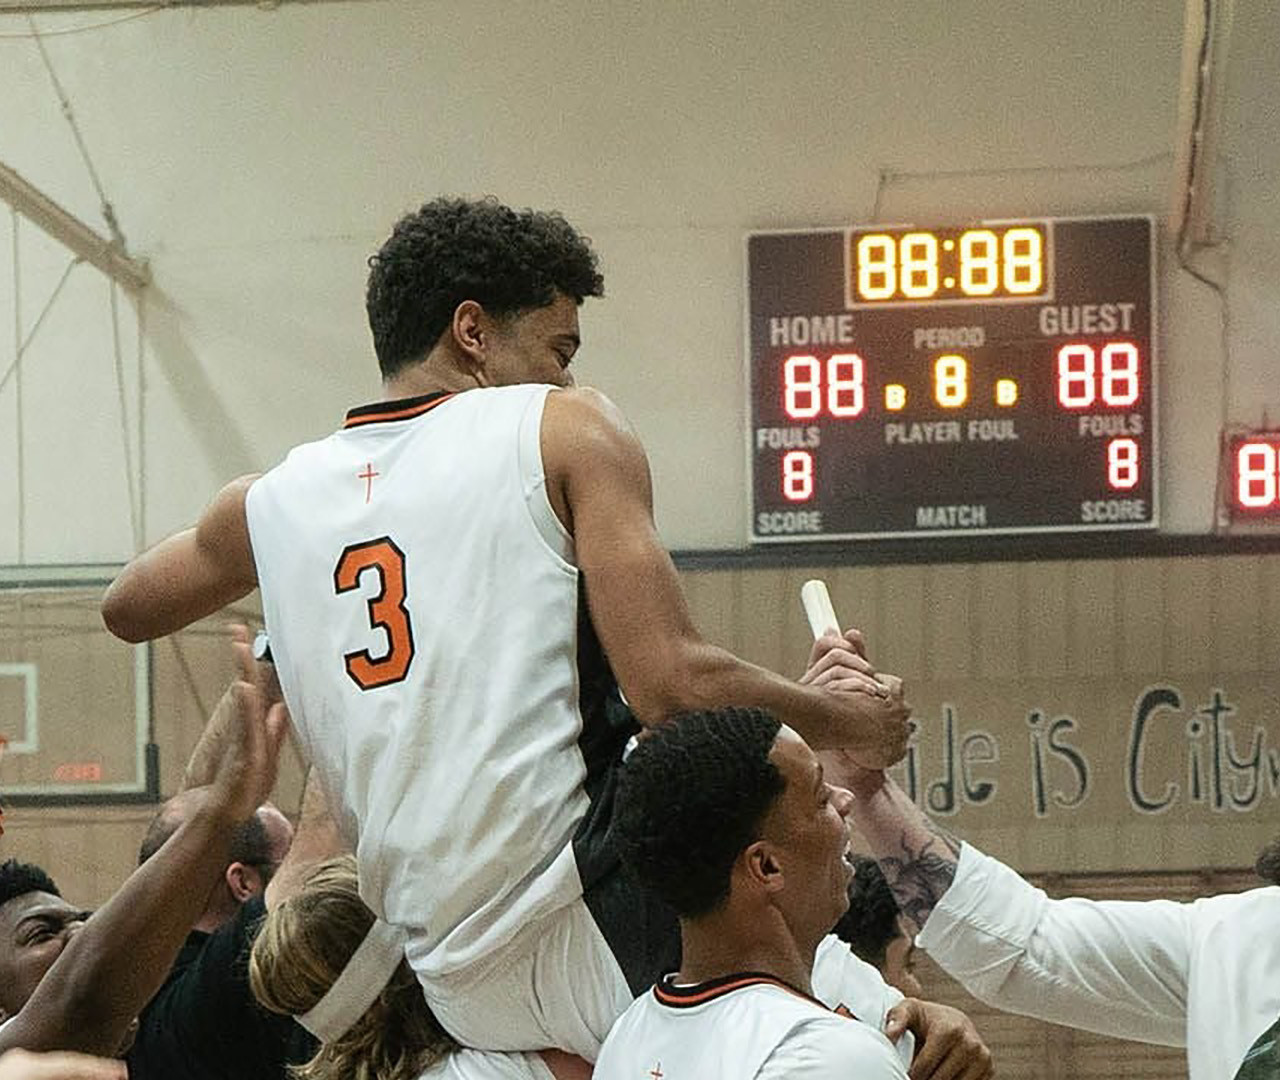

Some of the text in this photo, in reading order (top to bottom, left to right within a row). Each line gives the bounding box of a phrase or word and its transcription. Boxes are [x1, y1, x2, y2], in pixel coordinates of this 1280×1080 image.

[856, 228, 1042, 300] 88:88
[771, 315, 853, 346] HOME
[1040, 304, 1135, 335] GUEST
[914, 328, 984, 348] PERIOD
[784, 354, 864, 418] 88
[935, 355, 968, 408] 8
[1058, 343, 1139, 408] 88
[757, 428, 819, 449] FOULS
[885, 419, 1018, 444] PLAYER FOUL
[1080, 415, 1143, 436] FOULS
[783, 451, 813, 500] 8
[1108, 439, 1139, 488] 8
[758, 511, 821, 533] SCORE
[916, 506, 986, 527] MATCH
[1082, 501, 1145, 522] SCORE
[333, 535, 415, 691] 3
[906, 707, 999, 817] ide
[1027, 709, 1089, 818] is
